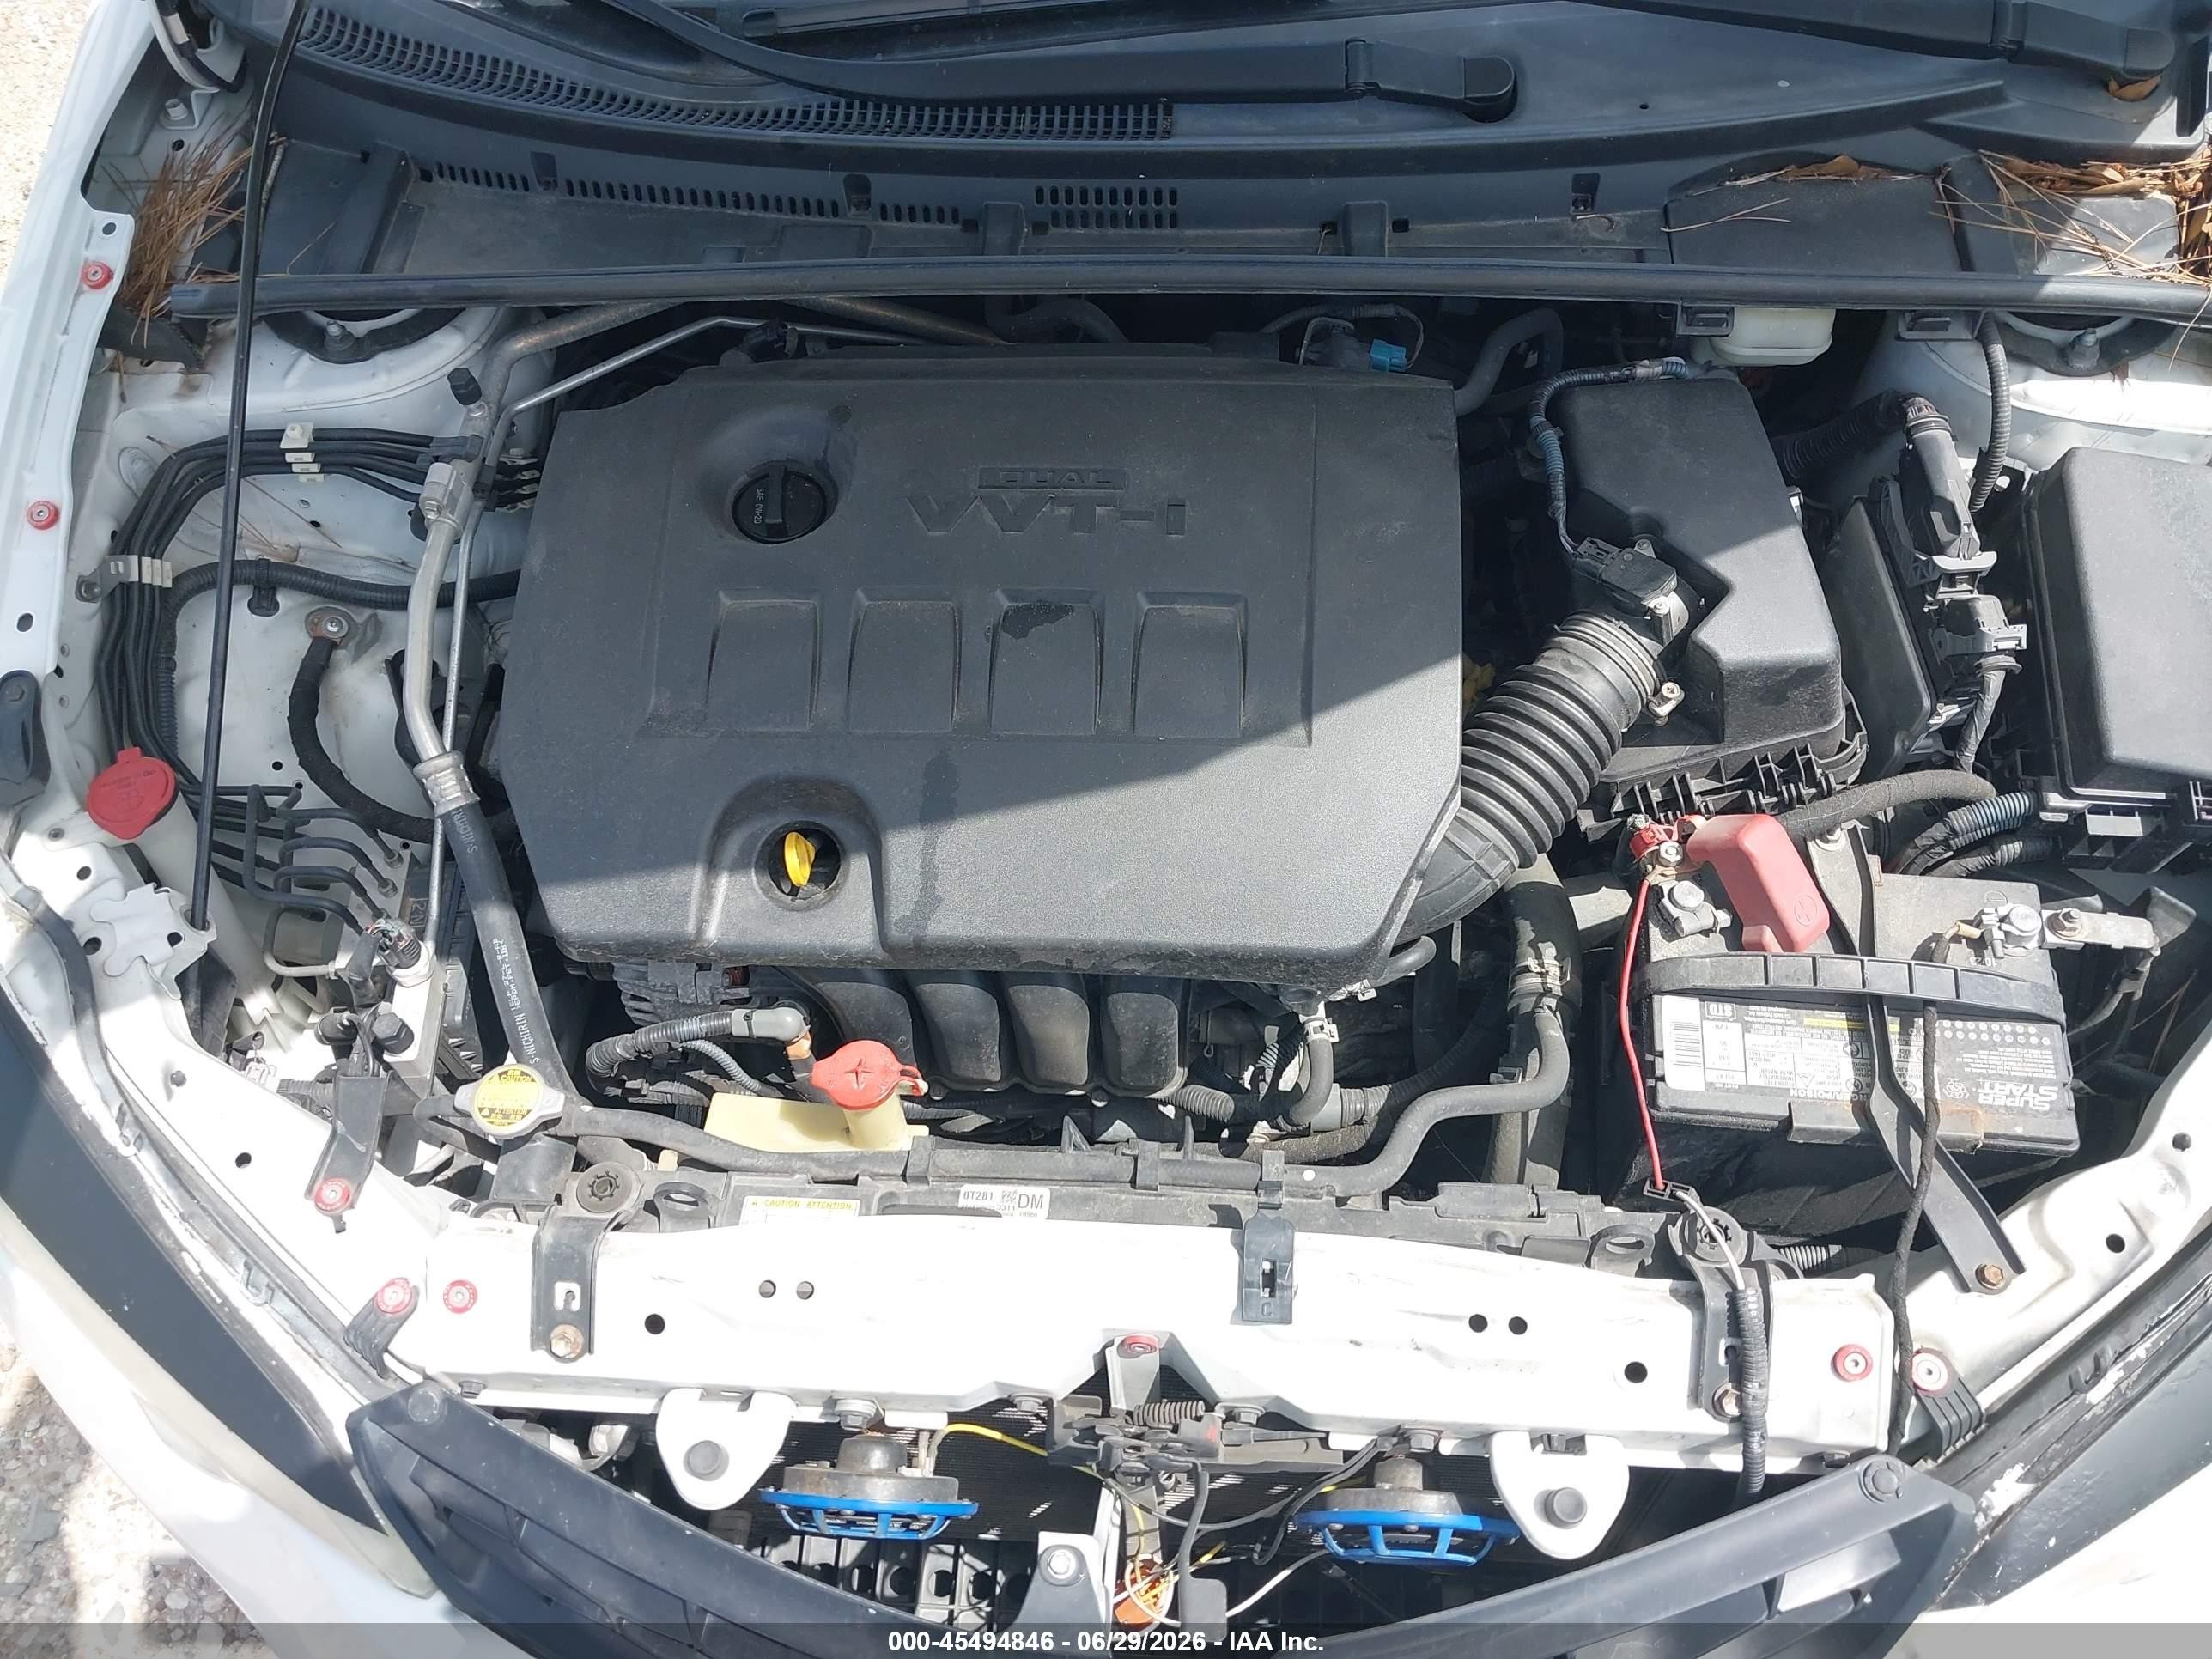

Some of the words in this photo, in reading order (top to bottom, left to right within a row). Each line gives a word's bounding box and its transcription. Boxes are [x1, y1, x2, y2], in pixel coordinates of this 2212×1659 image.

[1709, 1003, 1732, 1017] STD
[501, 1074, 532, 1083] CAUTION
[1790, 1089, 1868, 1101] NGER/POISON
[1977, 1081, 2058, 1102] START
[1978, 1092, 2051, 1111] SUPER
[764, 1199, 800, 1208] CAUTION
[806, 1200, 853, 1209] ATTENTION
[1018, 1194, 1044, 1209] DM
